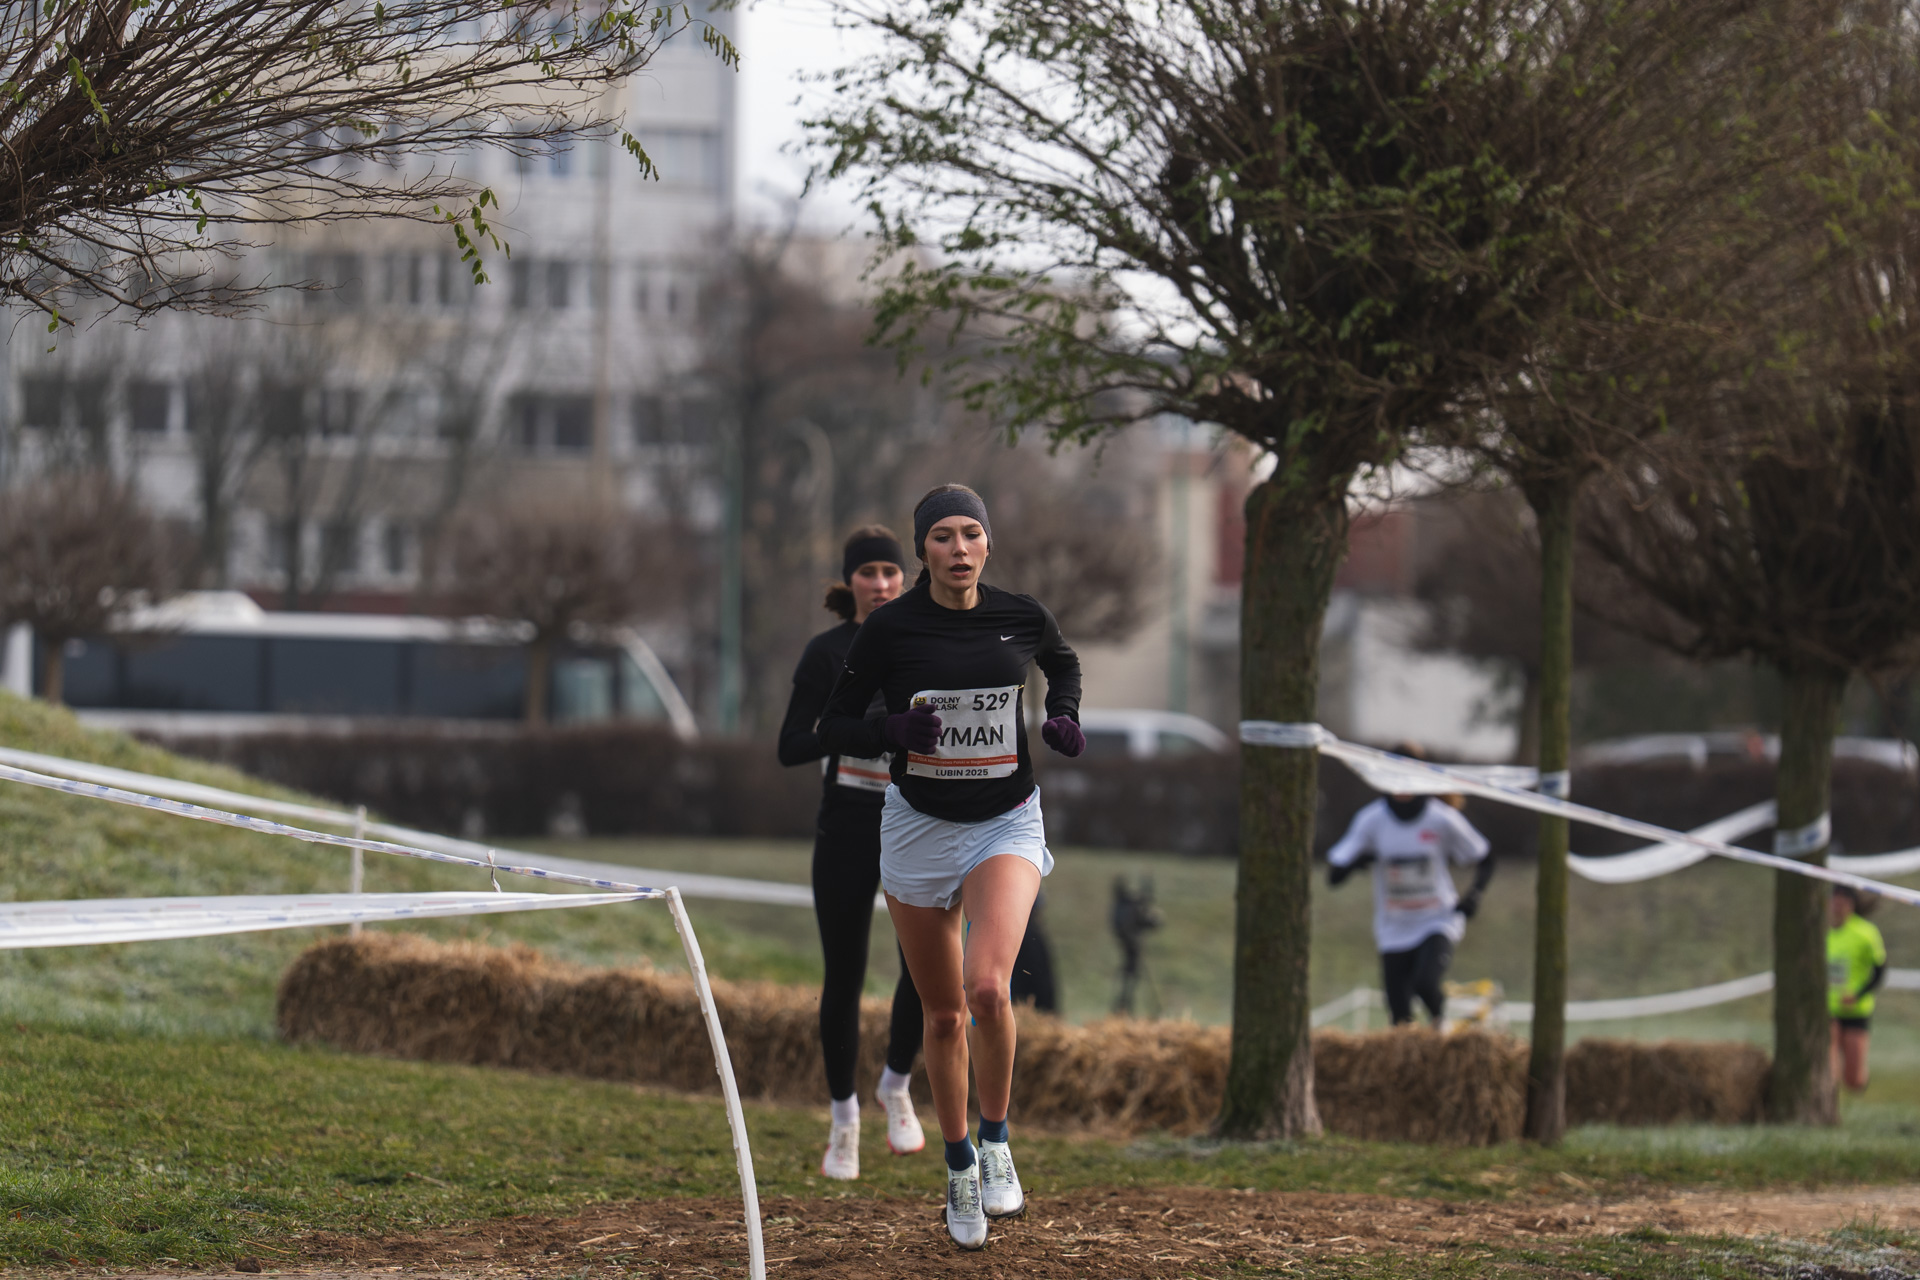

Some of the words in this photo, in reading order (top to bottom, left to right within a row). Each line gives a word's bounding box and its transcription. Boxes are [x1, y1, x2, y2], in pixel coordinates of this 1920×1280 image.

[930, 696, 961, 704] DOLNY
[972, 692, 1009, 711] 529
[935, 703, 959, 711] LĄSK
[938, 724, 1004, 747] YMAN
[935, 769, 963, 777] LUBIN
[965, 768, 989, 776] 2025
